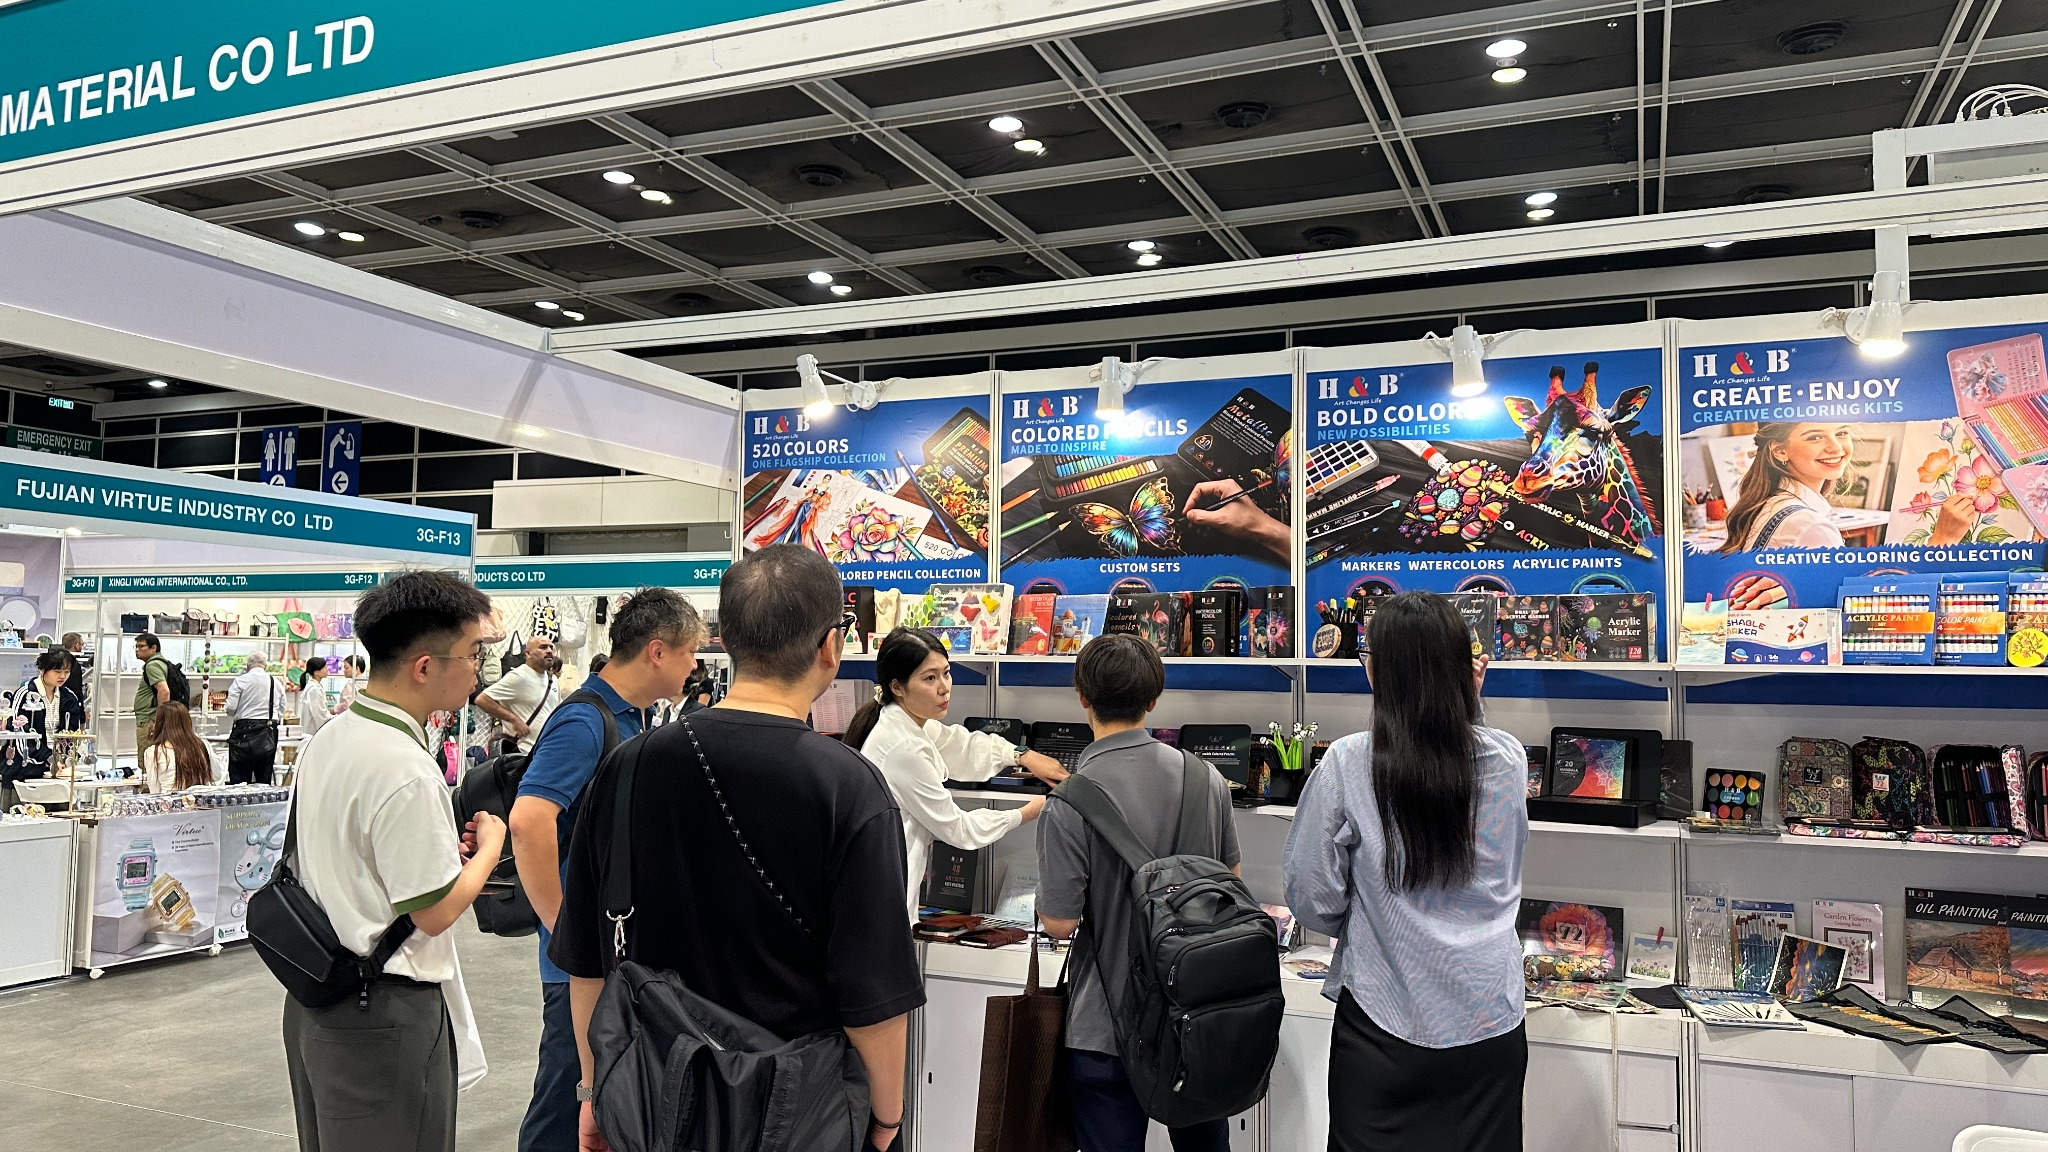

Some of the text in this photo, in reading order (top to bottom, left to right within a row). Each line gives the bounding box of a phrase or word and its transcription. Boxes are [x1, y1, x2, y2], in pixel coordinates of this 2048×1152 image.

[0, 15, 375, 136] MATERIAL CO LTD
[1726, 376, 1756, 385] Changes
[1757, 375, 1771, 383] Life
[1692, 377, 1901, 408] CREATE ENJOY
[1345, 399, 1369, 407] Changes
[1317, 401, 1476, 427] BOLD COLOR
[1692, 400, 1904, 423] CREATIVE COLORING KITS
[1011, 424, 1099, 444] COLORED
[1103, 418, 1188, 440] PCILS
[1317, 423, 1451, 441] NEW POSSIBILITIES
[17, 429, 72, 449] EMERGENCY
[74, 438, 93, 452] EXIT
[752, 438, 849, 459] 520 COLORS
[1011, 440, 1107, 455] MADE TO INSPIRE
[752, 453, 886, 469] ONE FLAGSHIP COLLECTION
[955, 441, 989, 471] PREMIUM
[17, 478, 462, 547] FUJIAN VIRTUE INDUSTRY CO LTD 3G-F13
[1530, 502, 1563, 518] RYLIC
[923, 541, 939, 552] 520
[1515, 529, 1550, 551] ACRY
[1341, 556, 1623, 572] MARKERS WATERCOLORS ACRYLIC PAINTS
[1754, 548, 2034, 566] CREATIVE COLORING COLLECTION
[511, 572, 526, 582] CO
[527, 571, 546, 582] LTD
[693, 568, 728, 580] 3G-F1
[839, 568, 981, 580] LORED PENCIL COLLECTION
[1099, 562, 1181, 574] CUSTOM SETS
[71, 578, 95, 588] 3G-F10
[108, 577, 132, 587] XINGLI
[133, 576, 155, 587] WONG
[156, 576, 214, 587] INTERNATIONAL
[344, 574, 373, 585] 3G-F12
[1608, 616, 1641, 627] Acrylic
[1727, 619, 1766, 630] SHABLE
[1846, 614, 1921, 622] ACRYLIC PAINT
[1608, 627, 1642, 636] Marker
[1727, 628, 1758, 636] ARKER
[173, 822, 202, 836] Virtue
[1823, 912, 1872, 923] Garden Flowers
[1915, 903, 1999, 920] OIL PAINTING
[1559, 925, 1583, 942] 72
